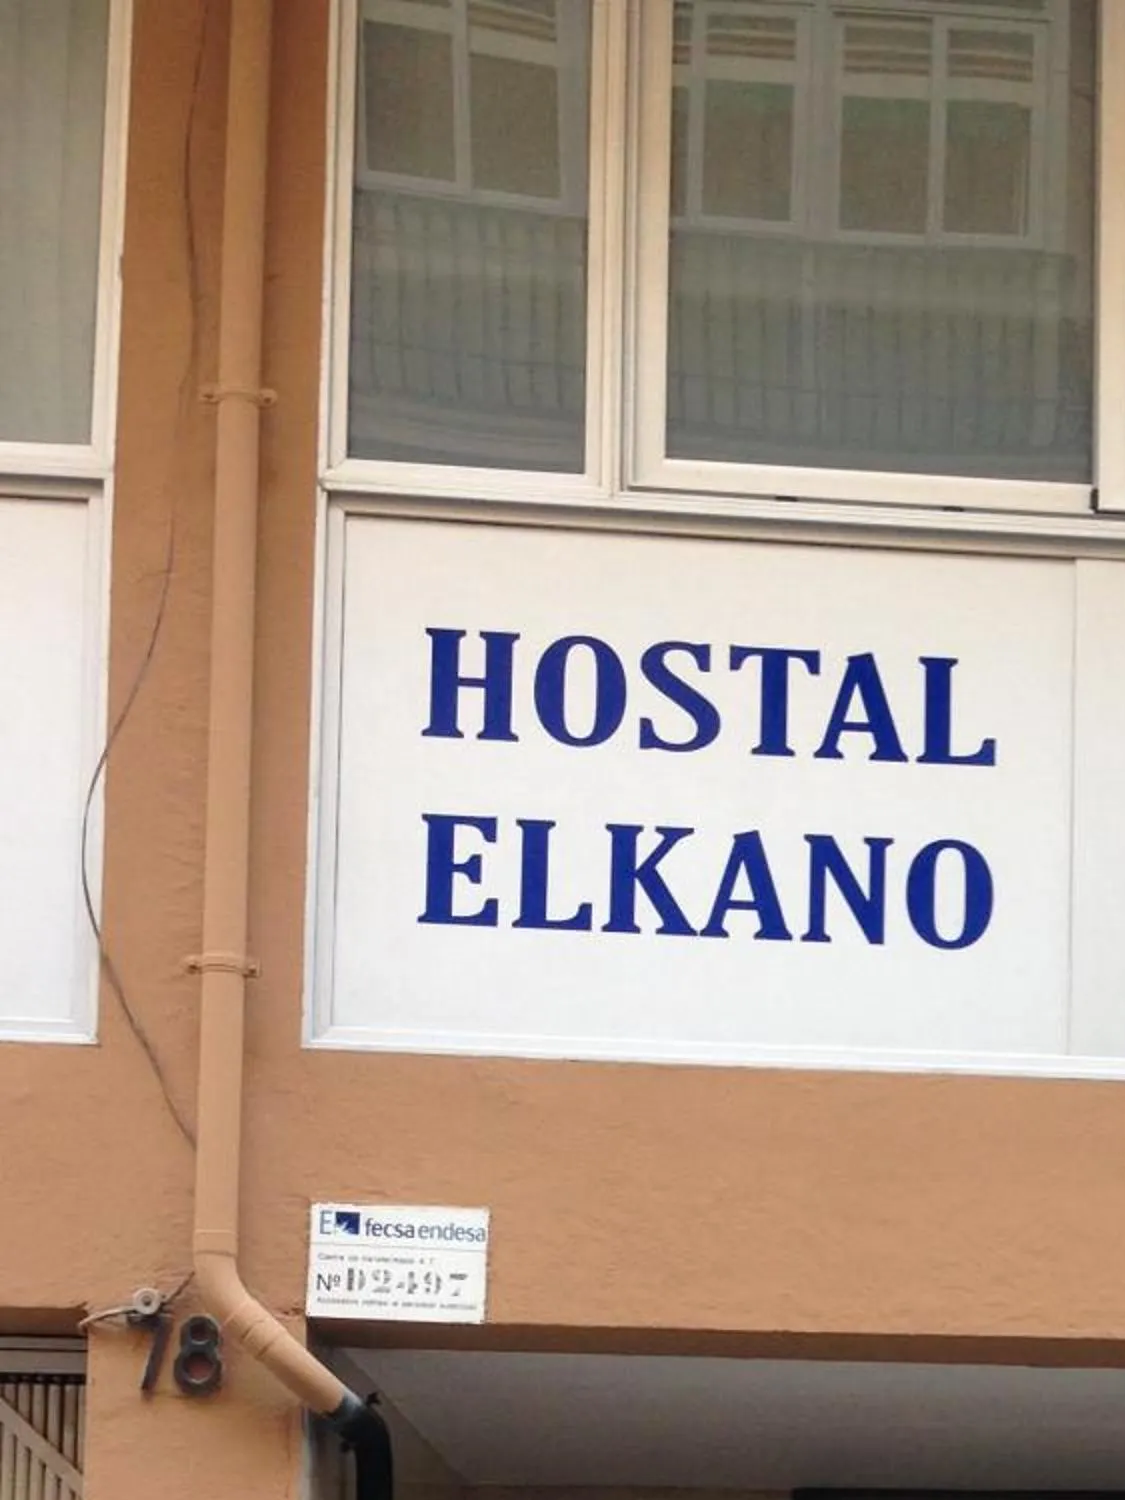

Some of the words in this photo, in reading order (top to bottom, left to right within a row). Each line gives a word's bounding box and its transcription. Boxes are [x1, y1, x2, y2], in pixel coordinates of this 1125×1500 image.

[420, 627, 996, 766] HOSTAL
[417, 813, 994, 950] ELKANO
[127, 1312, 223, 1398] 78
